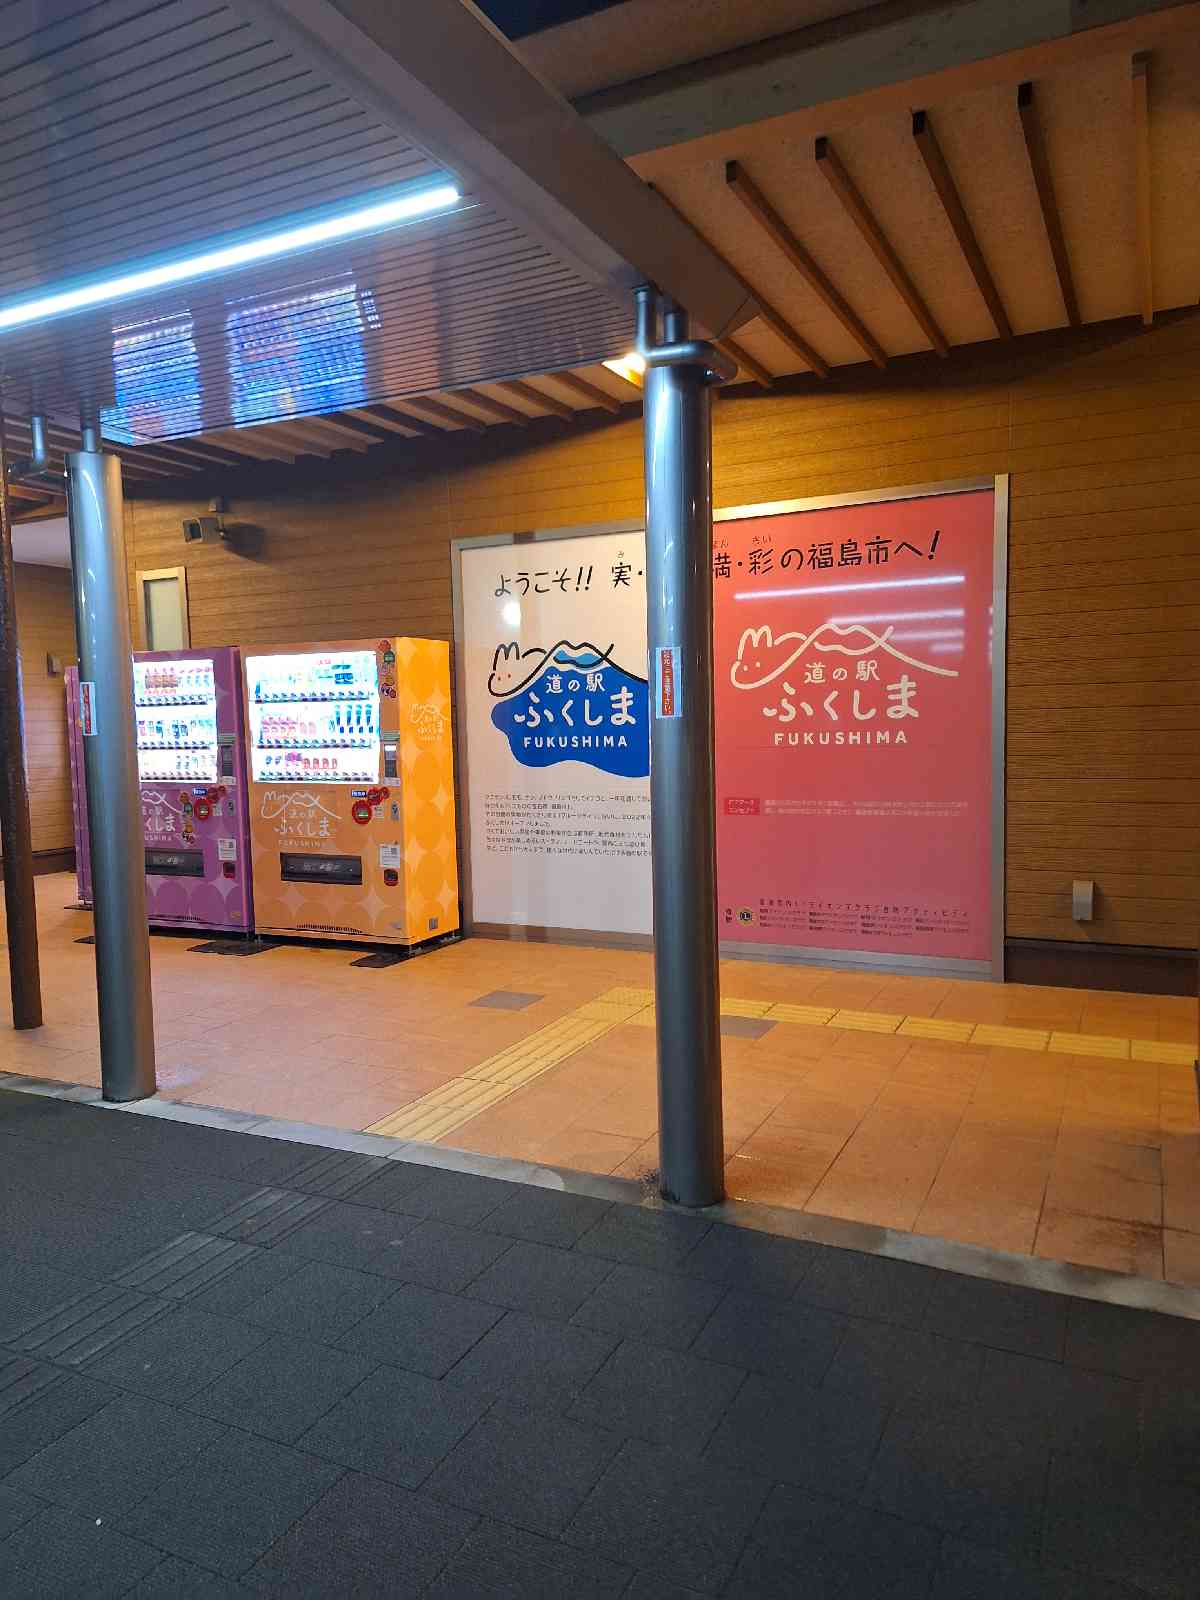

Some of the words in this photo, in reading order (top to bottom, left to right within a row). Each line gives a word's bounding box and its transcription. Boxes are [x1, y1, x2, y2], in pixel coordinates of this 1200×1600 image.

[495, 565, 593, 597] ようこそ!!
[544, 672, 606, 694] 道の駅
[804, 661, 880, 684] 道の駅
[513, 686, 637, 728] ふくしま
[763, 674, 919, 722] ふくしま
[523, 735, 628, 749] FUKUSHIMA
[773, 730, 908, 745] FUKUSHIMA
